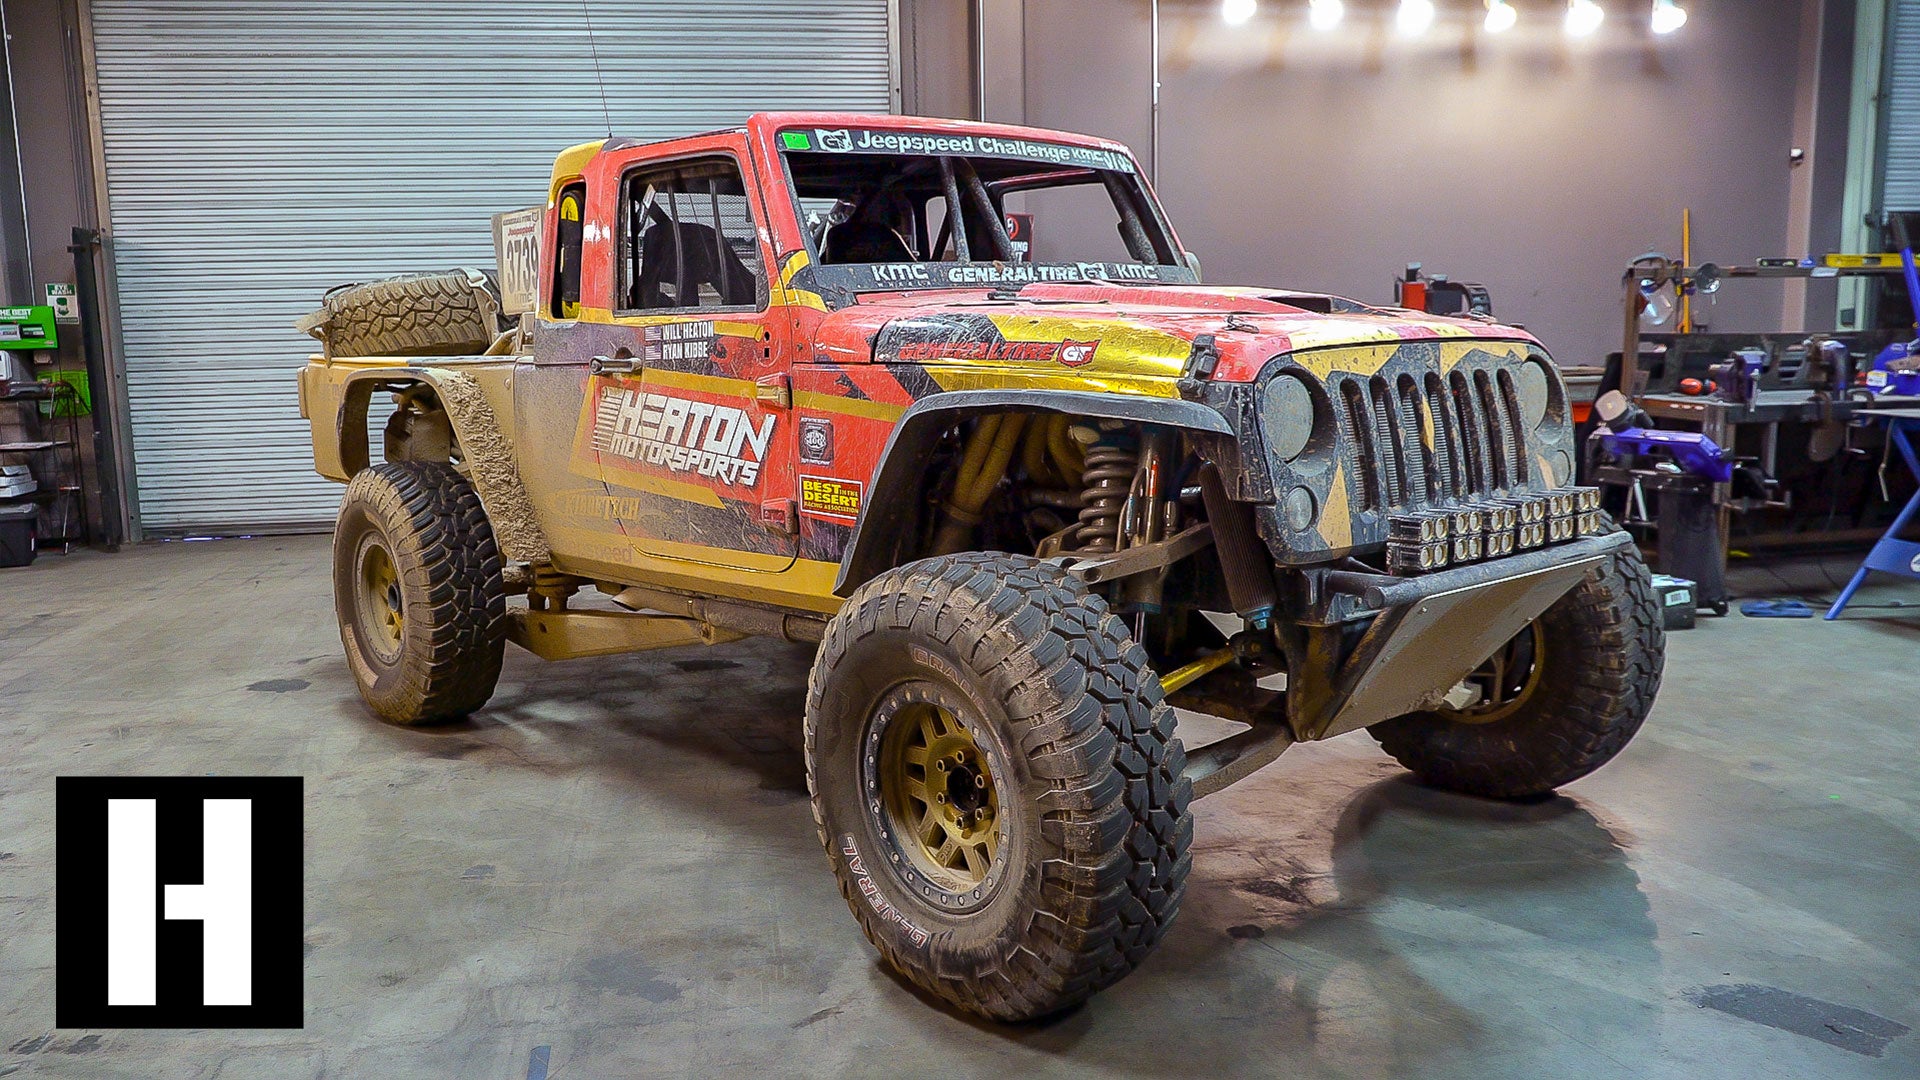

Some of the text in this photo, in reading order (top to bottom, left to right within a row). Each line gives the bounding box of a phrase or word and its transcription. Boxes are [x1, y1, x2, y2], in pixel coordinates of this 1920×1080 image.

[857, 130, 974, 154] Jeepspeed
[979, 137, 1071, 163] Challenge
[506, 235, 538, 295] 3739
[870, 264, 929, 281] KMC
[948, 266, 1079, 282] GENERAL TIRE
[1115, 264, 1159, 279] KMC
[662, 321, 714, 340] WILL HEATON
[662, 342, 682, 360] RYAN
[614, 390, 777, 462] HEATON
[609, 432, 761, 487] MOTORSPORTS
[803, 480, 841, 494] BEST
[803, 491, 859, 507] DESERT
[803, 501, 823, 509] RACING
[842, 836, 927, 949] GENERAL
